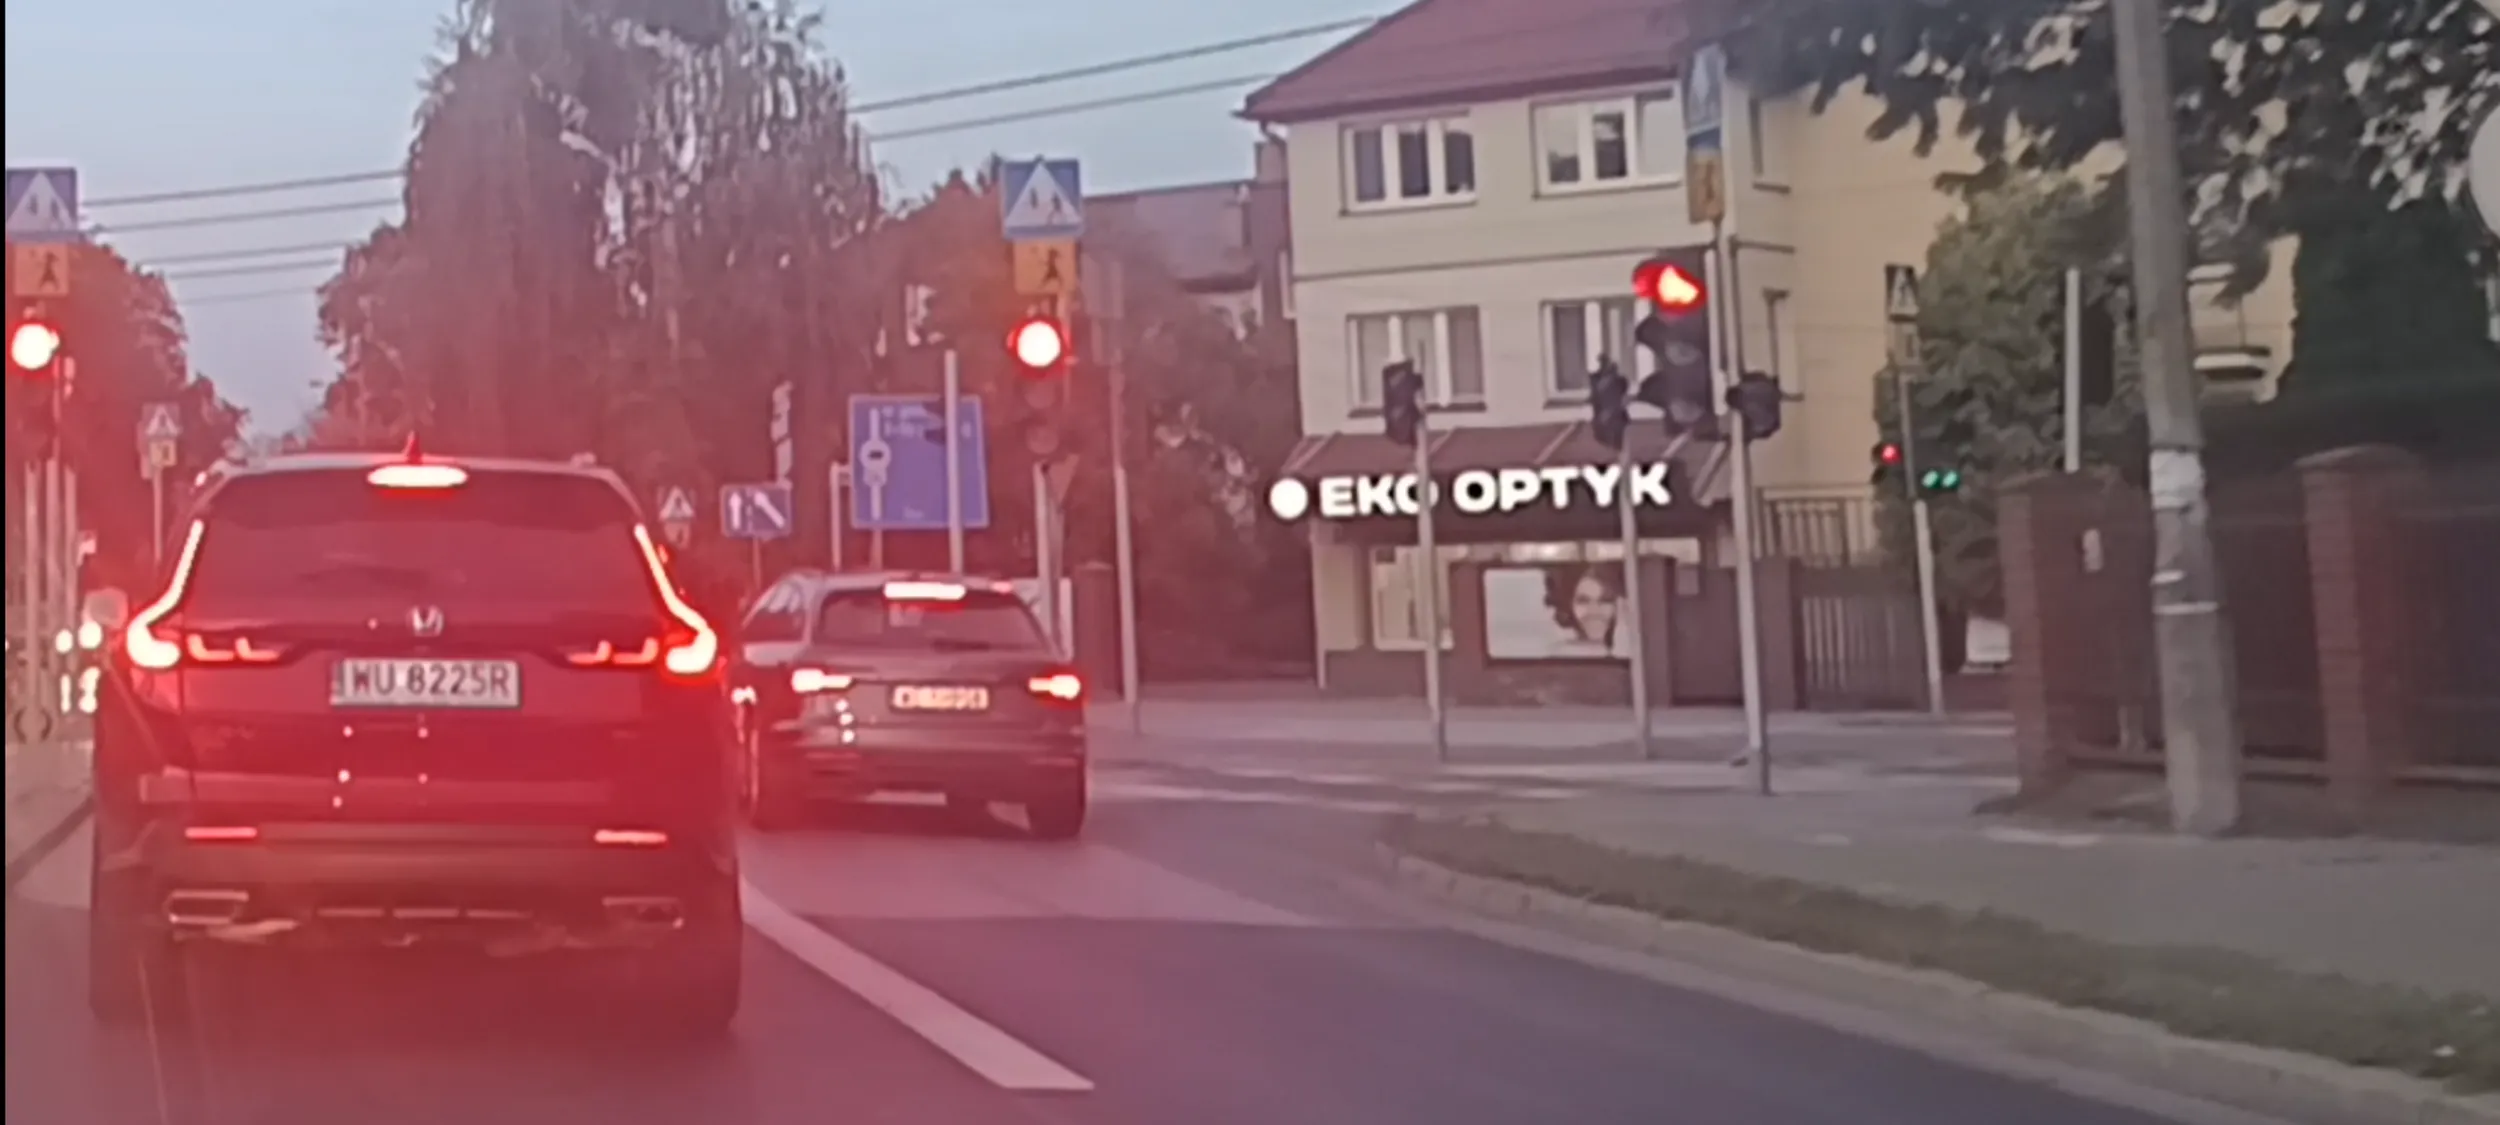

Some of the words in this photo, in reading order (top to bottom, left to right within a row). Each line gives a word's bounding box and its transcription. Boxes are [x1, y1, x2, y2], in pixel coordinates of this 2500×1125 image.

[1319, 472, 1439, 517] EKO
[1452, 461, 1671, 512] OPTYK
[352, 663, 396, 695] WU
[407, 663, 510, 695] 8225R
